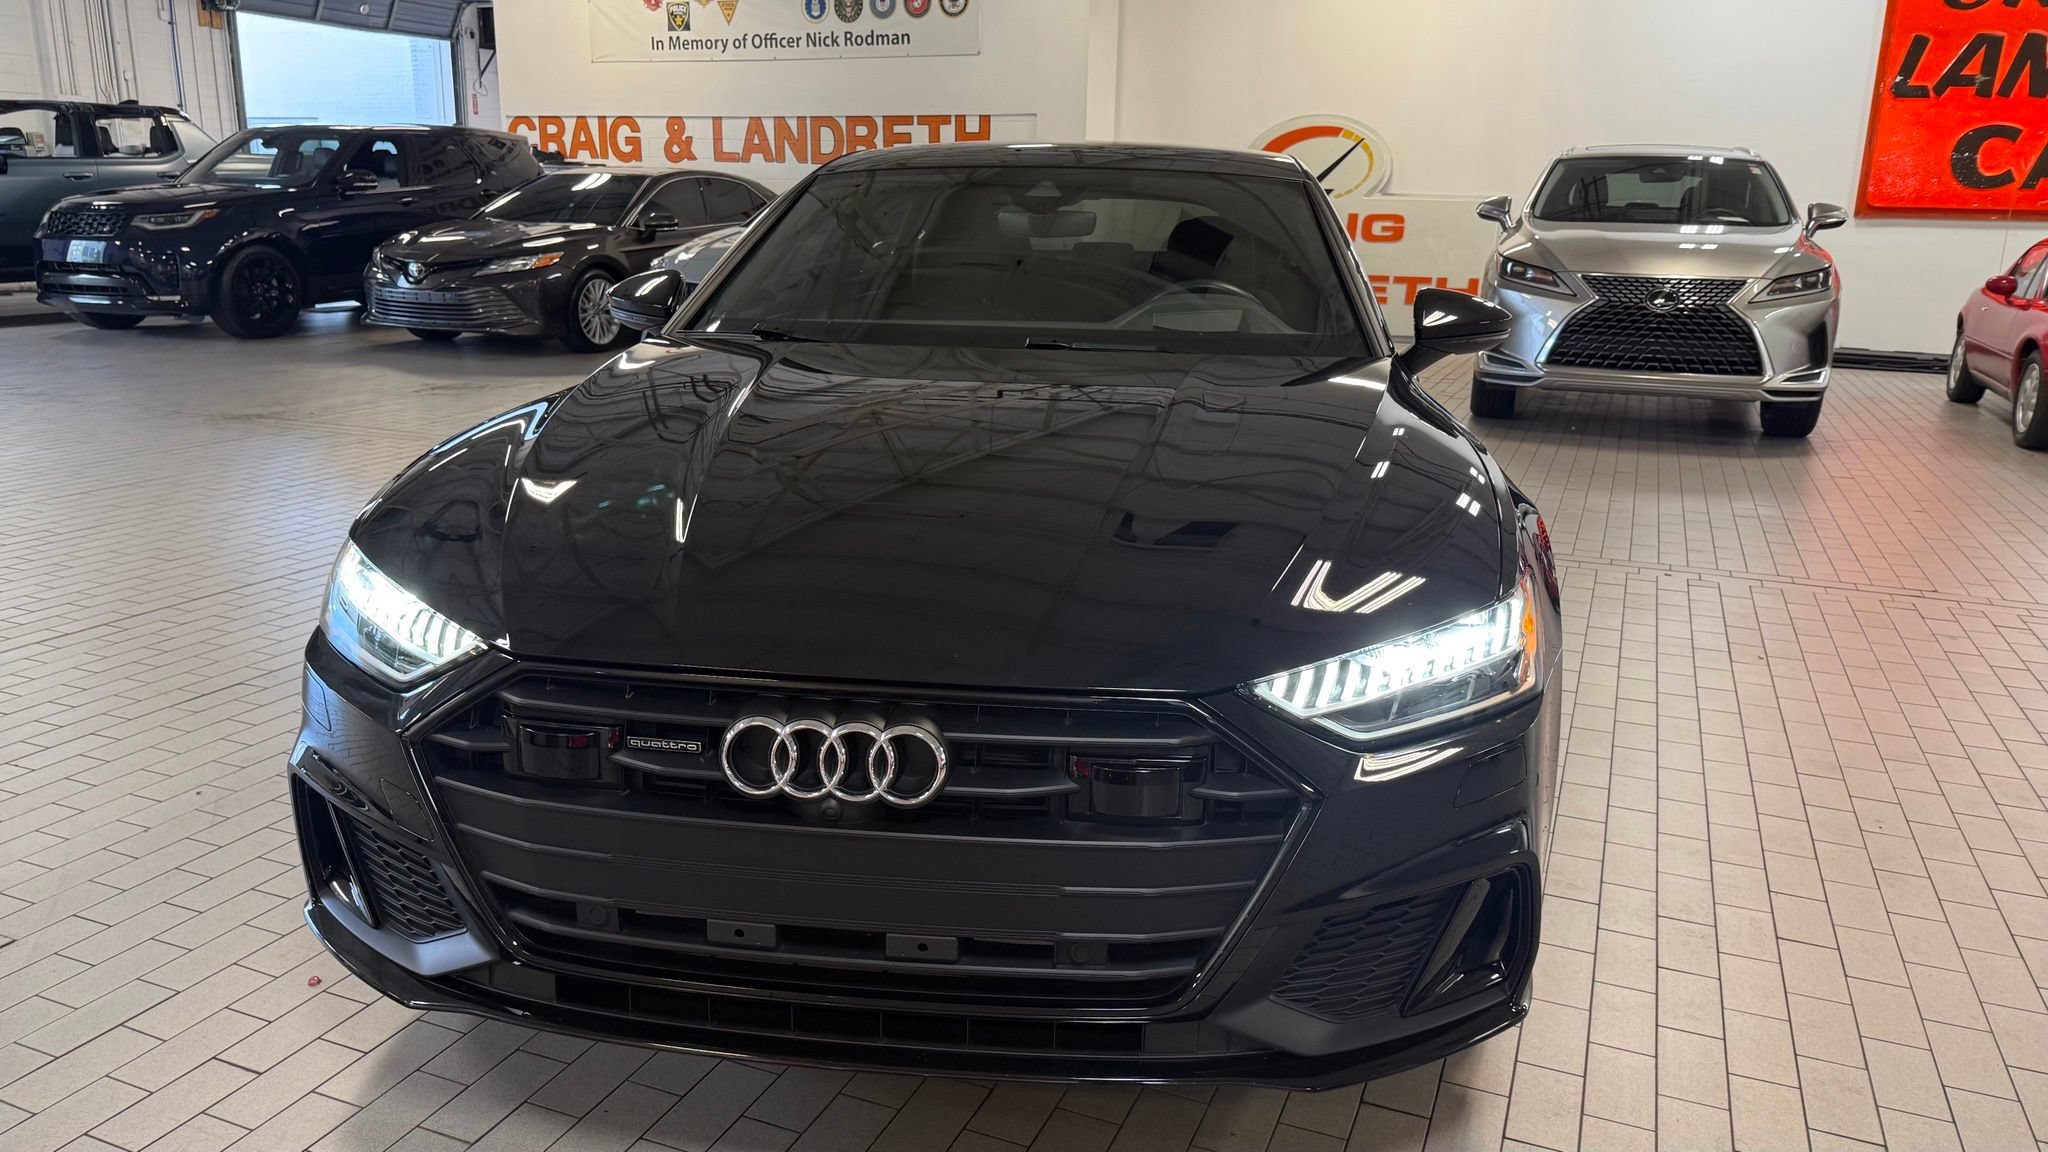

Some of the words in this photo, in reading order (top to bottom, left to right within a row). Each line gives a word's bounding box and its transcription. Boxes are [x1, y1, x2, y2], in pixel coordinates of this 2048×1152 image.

[651, 36, 664, 51] In
[668, 36, 729, 53] Memory
[733, 33, 748, 49] of
[751, 33, 802, 49] Officer
[806, 31, 840, 48] Nick
[844, 30, 911, 47] Rodman
[508, 115, 643, 163] CRAIG
[664, 116, 697, 163] &
[712, 115, 990, 164] LANDRETH
[1346, 212, 1405, 244] IG
[630, 739, 697, 751] quattro
